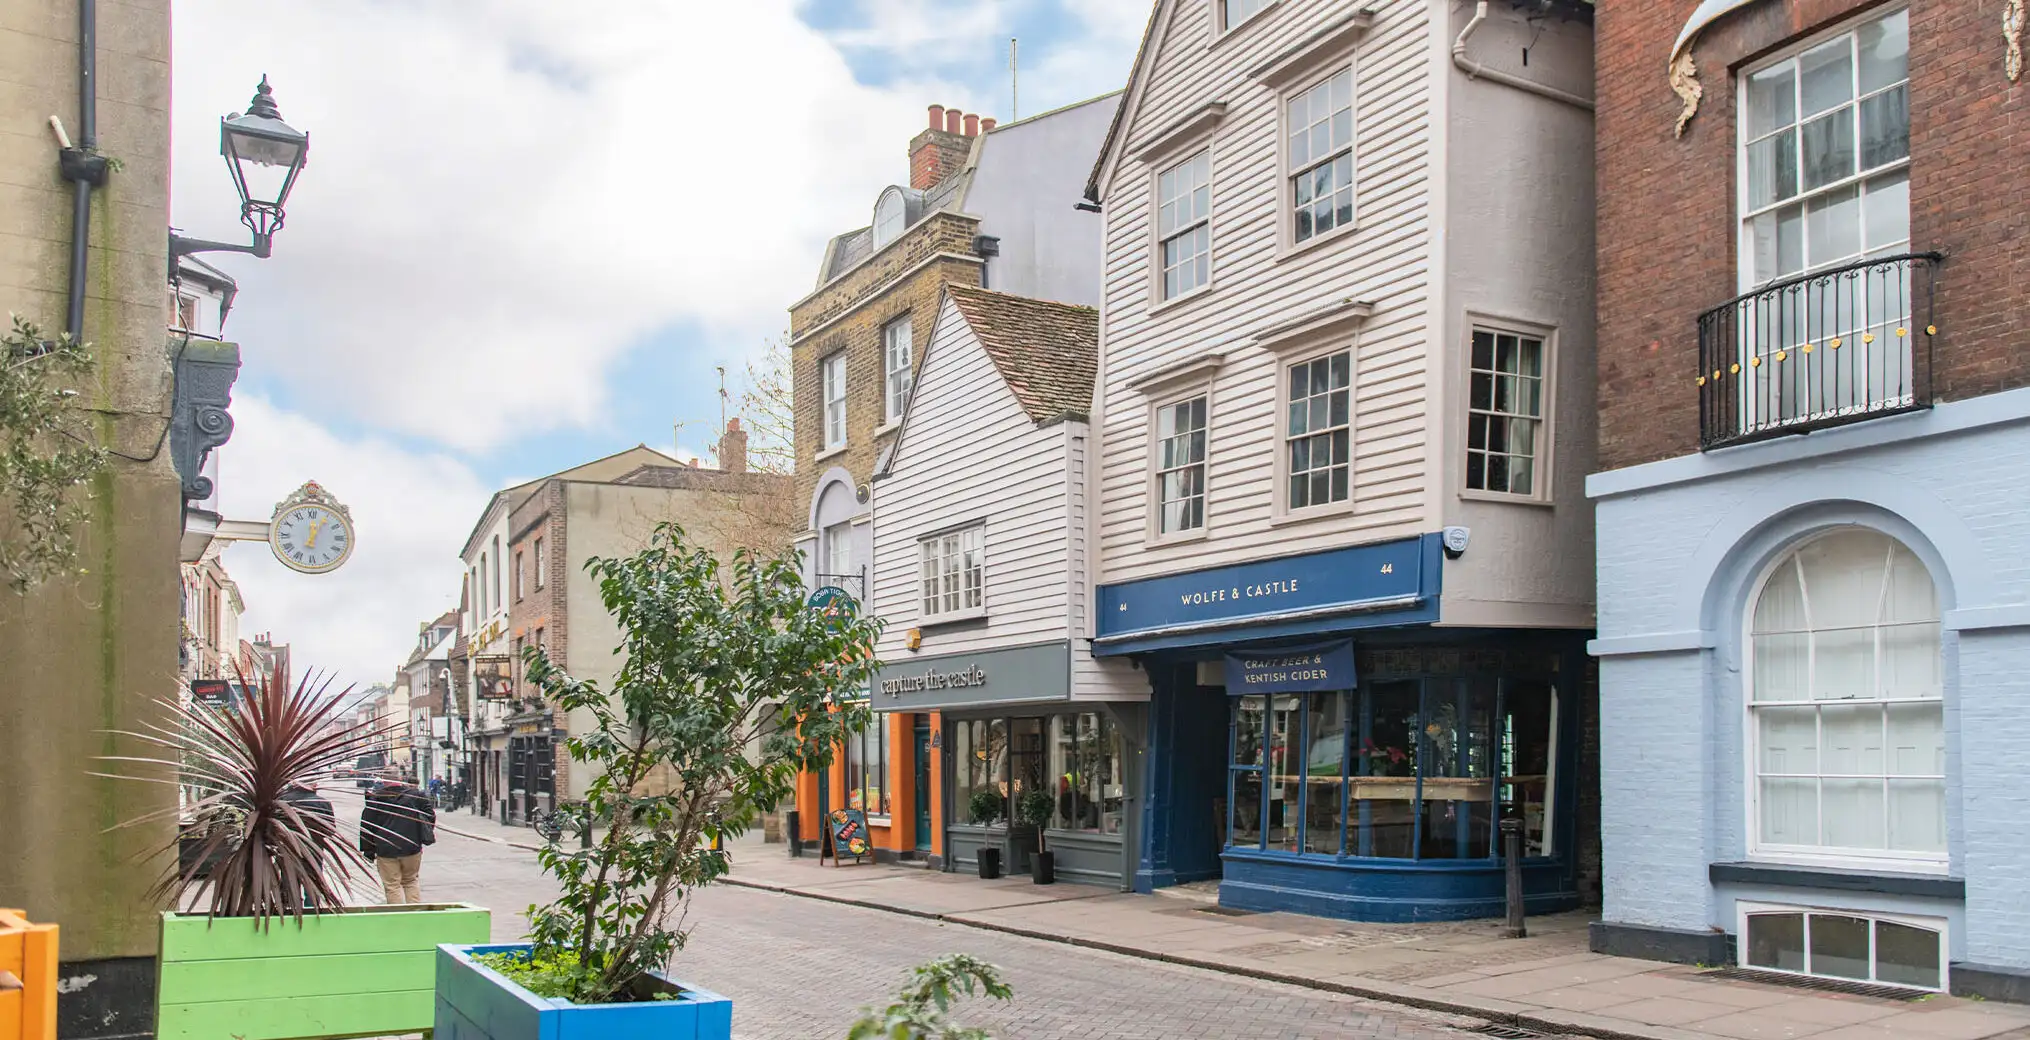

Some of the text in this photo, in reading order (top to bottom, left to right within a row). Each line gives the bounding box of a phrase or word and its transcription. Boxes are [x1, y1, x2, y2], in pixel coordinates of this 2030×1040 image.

[1380, 563, 1392, 574] 44
[1181, 579, 1298, 605] WOLFE & CASTLE
[1119, 603, 1127, 612] 44
[1245, 654, 1321, 670] CRAFT BEER &
[880, 663, 985, 698] capture the castle
[1245, 669, 1328, 684] KENTISH CIDER
